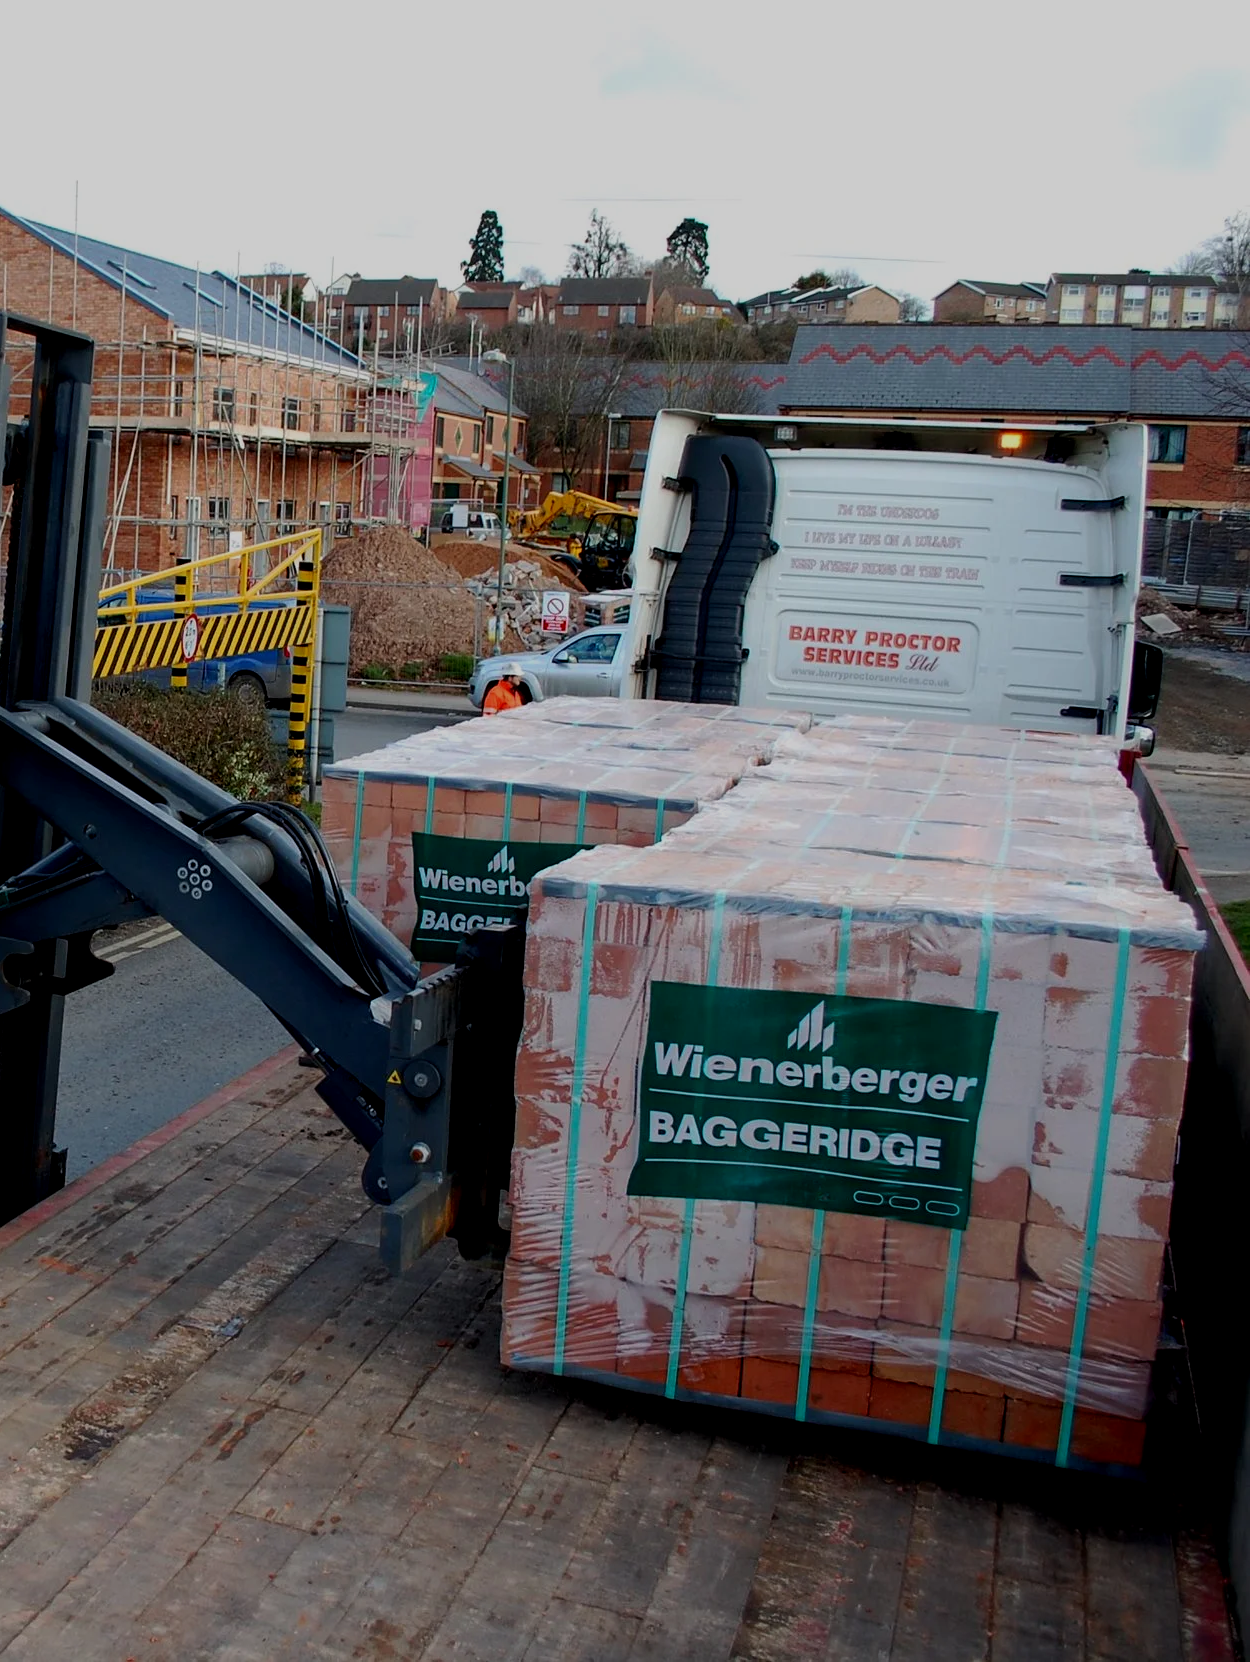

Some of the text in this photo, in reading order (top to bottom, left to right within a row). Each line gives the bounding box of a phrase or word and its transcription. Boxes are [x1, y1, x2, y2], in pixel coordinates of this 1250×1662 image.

[902, 535, 912, 548] A
[788, 626, 961, 653] BARRY PROCTOR
[803, 646, 938, 672] SERVICES Ltd
[791, 668, 950, 687] www.barryproctorservices.co.uk
[654, 1041, 978, 1104] Wienerberger
[648, 1110, 942, 1170] BAGGERIDGE
